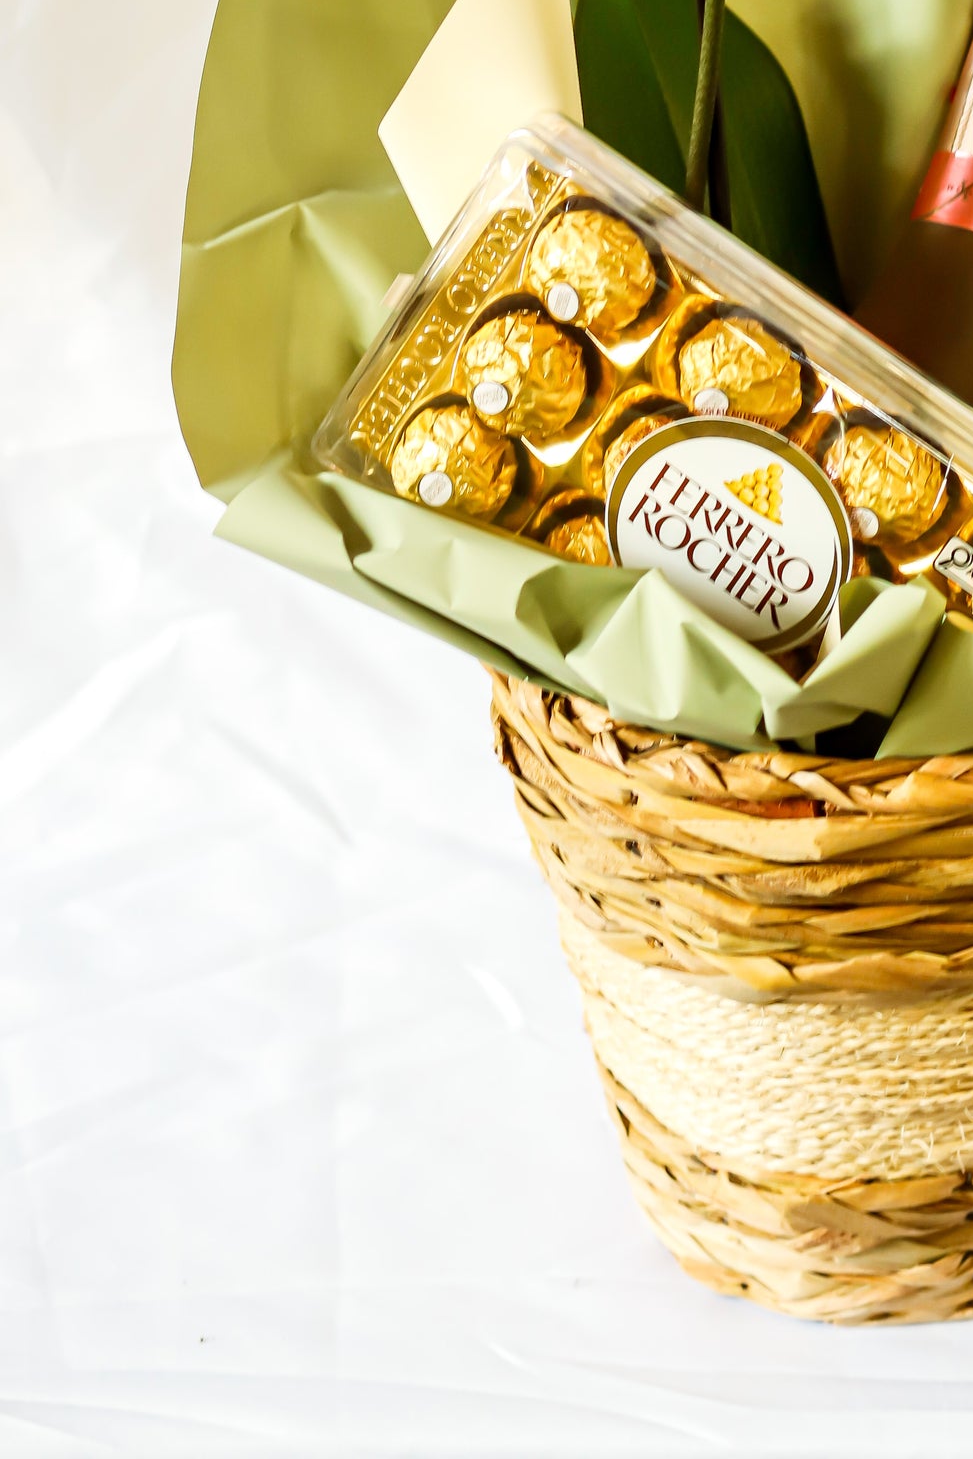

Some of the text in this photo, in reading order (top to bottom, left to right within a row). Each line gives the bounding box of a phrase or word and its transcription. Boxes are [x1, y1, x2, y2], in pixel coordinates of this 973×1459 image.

[350, 314, 463, 449] ROCHER
[628, 493, 788, 631] ROCHER
[650, 462, 814, 593] FERRERO
